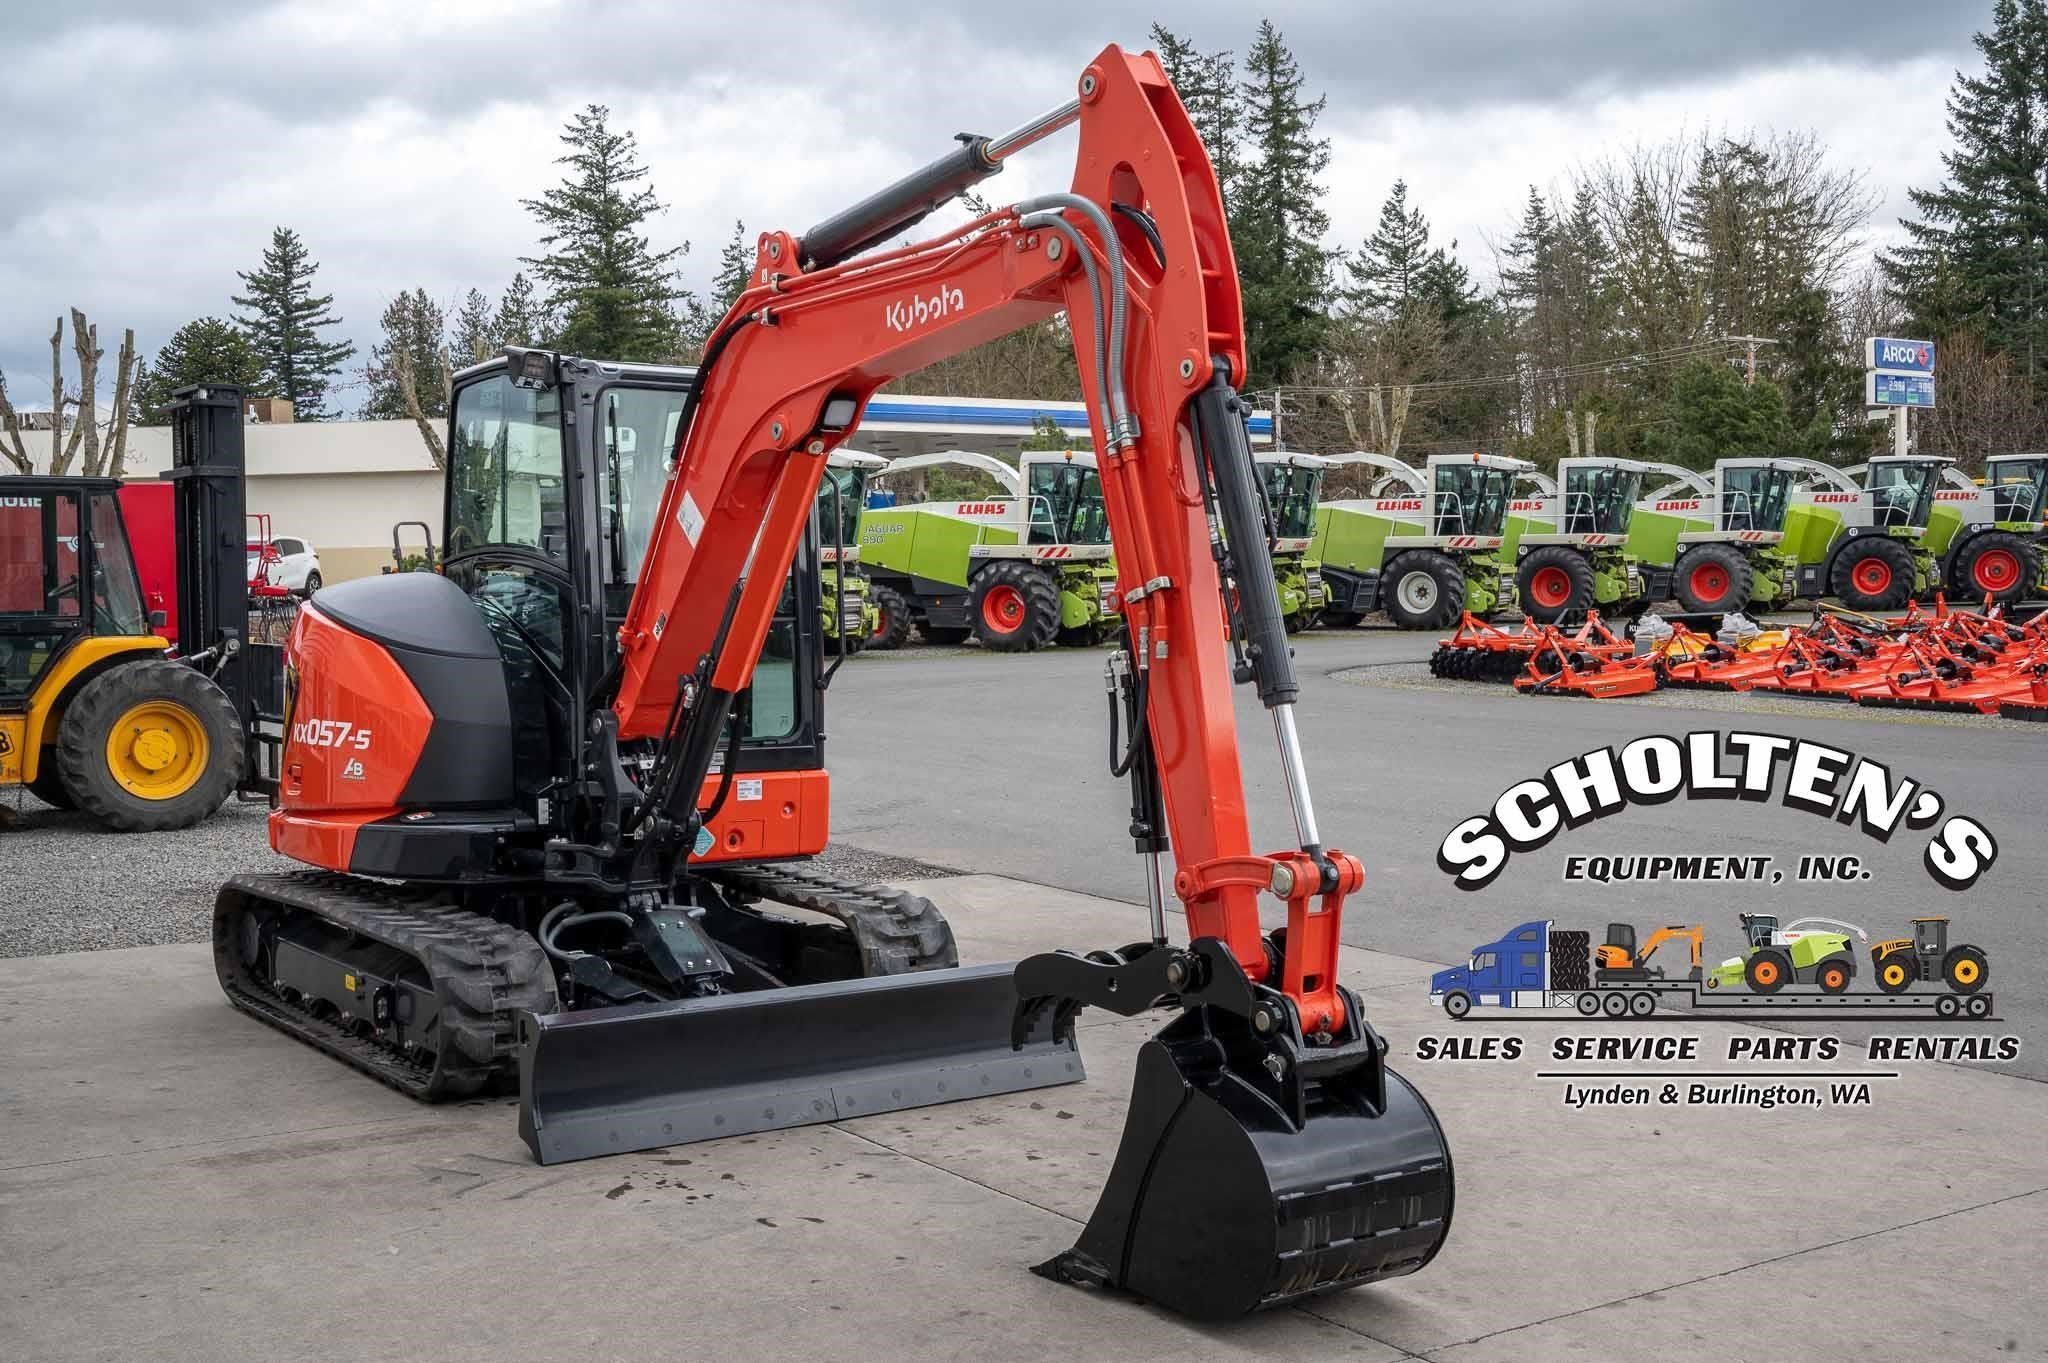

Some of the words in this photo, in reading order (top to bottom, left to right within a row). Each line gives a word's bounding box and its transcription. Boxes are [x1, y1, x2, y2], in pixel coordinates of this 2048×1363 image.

[886, 284, 964, 332] Kubota
[1882, 345, 1915, 364] ARCO
[1813, 494, 1859, 503] CLAAS
[1935, 491, 1979, 501] CLAAS
[958, 503, 1006, 515] CLAAS
[1375, 501, 1422, 511] CLAAS
[1505, 501, 1543, 511] LAAS
[1656, 500, 1700, 511] CLAAS
[863, 523, 905, 534] JAGUAR
[293, 718, 372, 750] KX057-5
